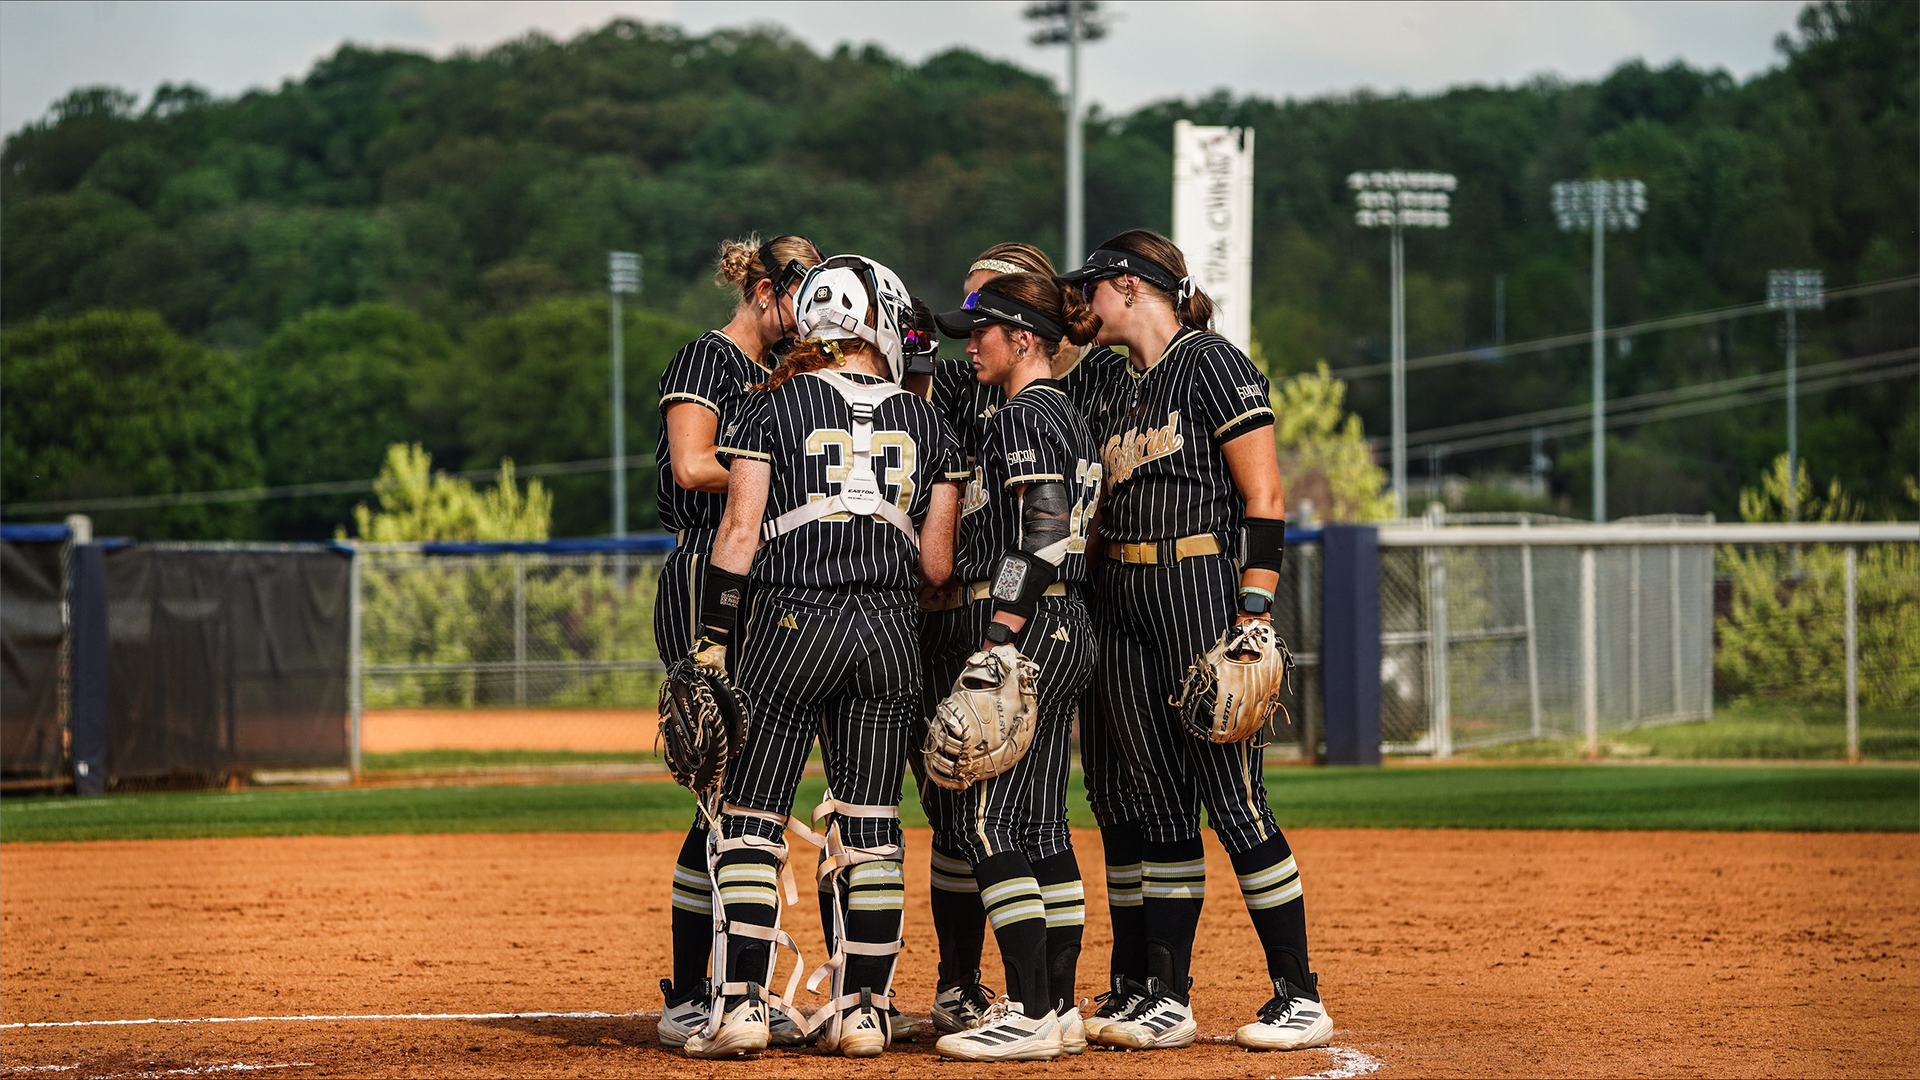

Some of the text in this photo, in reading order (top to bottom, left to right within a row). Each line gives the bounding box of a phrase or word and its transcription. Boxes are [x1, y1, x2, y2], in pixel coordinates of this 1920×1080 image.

[806, 429, 917, 523] 33
[1007, 449, 1036, 465] SOCON
[682, 697, 698, 734] ASTON
[1220, 692, 1234, 732] EASTON
